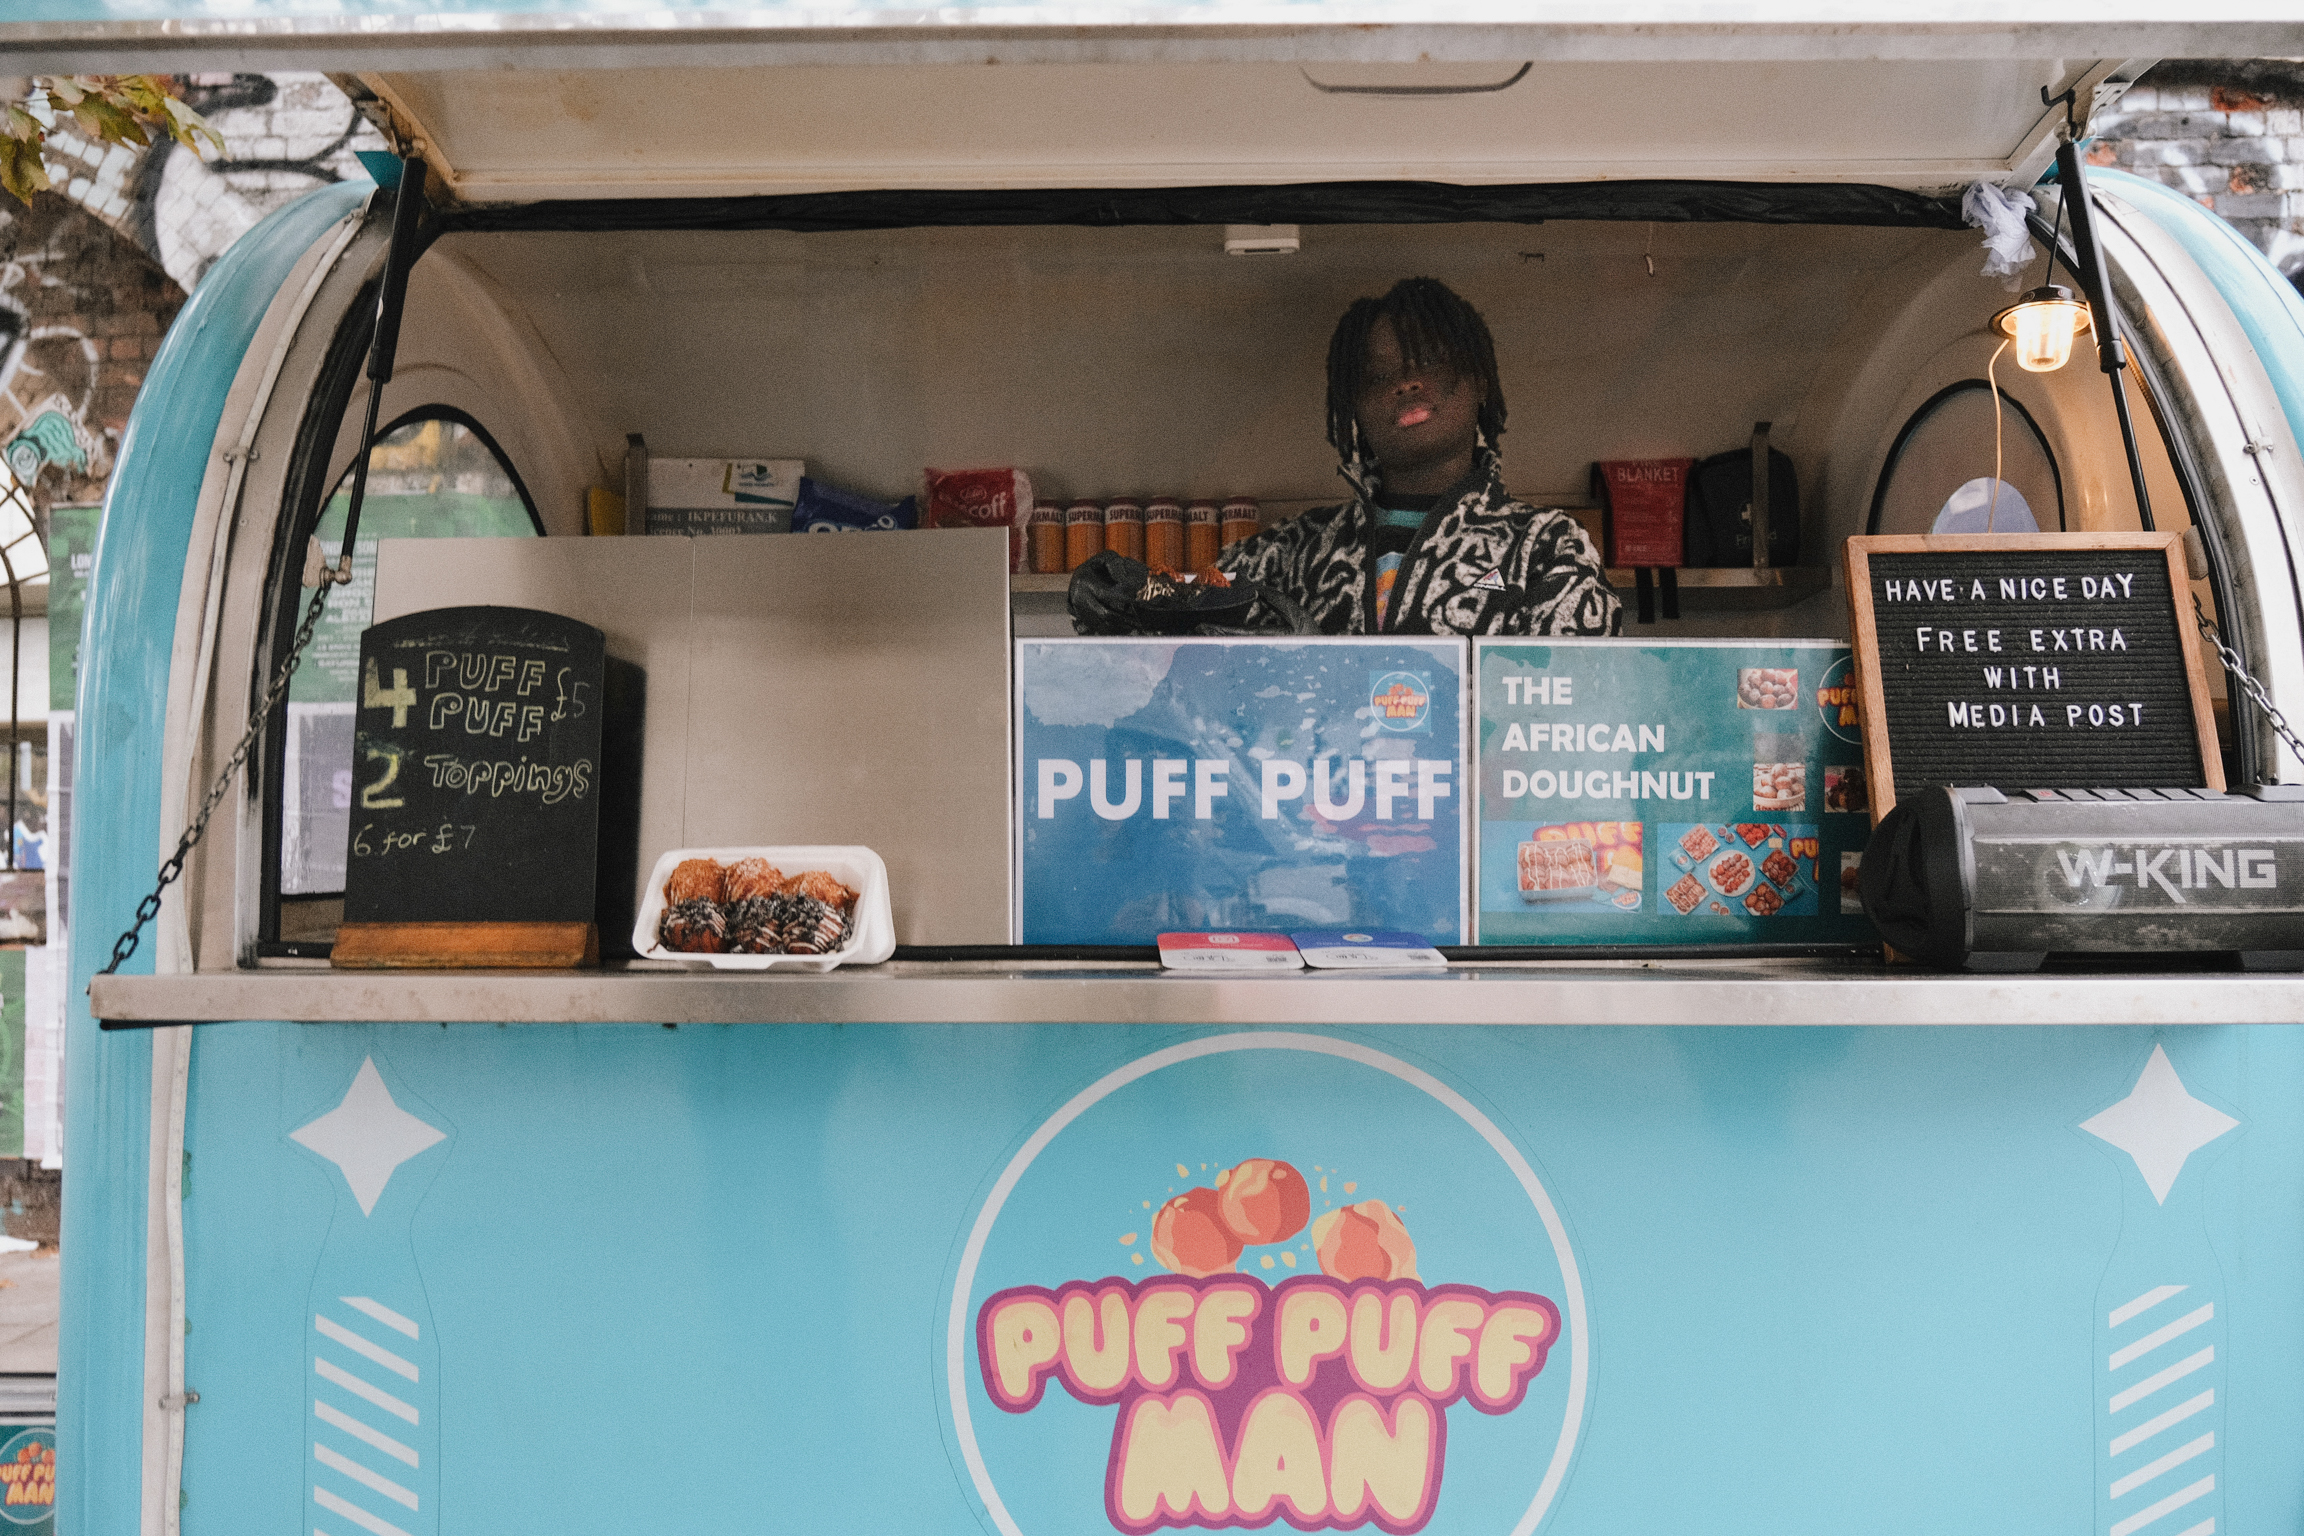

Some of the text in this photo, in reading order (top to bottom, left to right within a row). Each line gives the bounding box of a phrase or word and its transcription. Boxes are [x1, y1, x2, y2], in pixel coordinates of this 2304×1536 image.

[1617, 466, 1680, 482] BLANKET
[1885, 573, 2133, 602] HAVE A NICE DAY
[1916, 626, 2127, 652] FREE EXTRA
[363, 656, 417, 728] 4
[425, 651, 546, 696] PUFF
[1502, 676, 1573, 706] THE
[1983, 665, 2060, 690] WITH
[429, 692, 544, 742] PUFF
[1386, 705, 1416, 719] MAN
[1947, 701, 2144, 728] MEDIA POST
[1502, 723, 1665, 753] AFRICAN
[362, 748, 405, 809] 2
[1038, 758, 1453, 821] PUFF PUFF
[1502, 770, 1715, 800] DOUGHNUT
[353, 823, 374, 856] 6
[382, 831, 427, 856] for
[2055, 849, 2277, 904] W-KING
[988, 1284, 1548, 1404] PUFF PUFF
[1118, 1389, 1435, 1526] MAN
[0, 1463, 33, 1483] UFF
